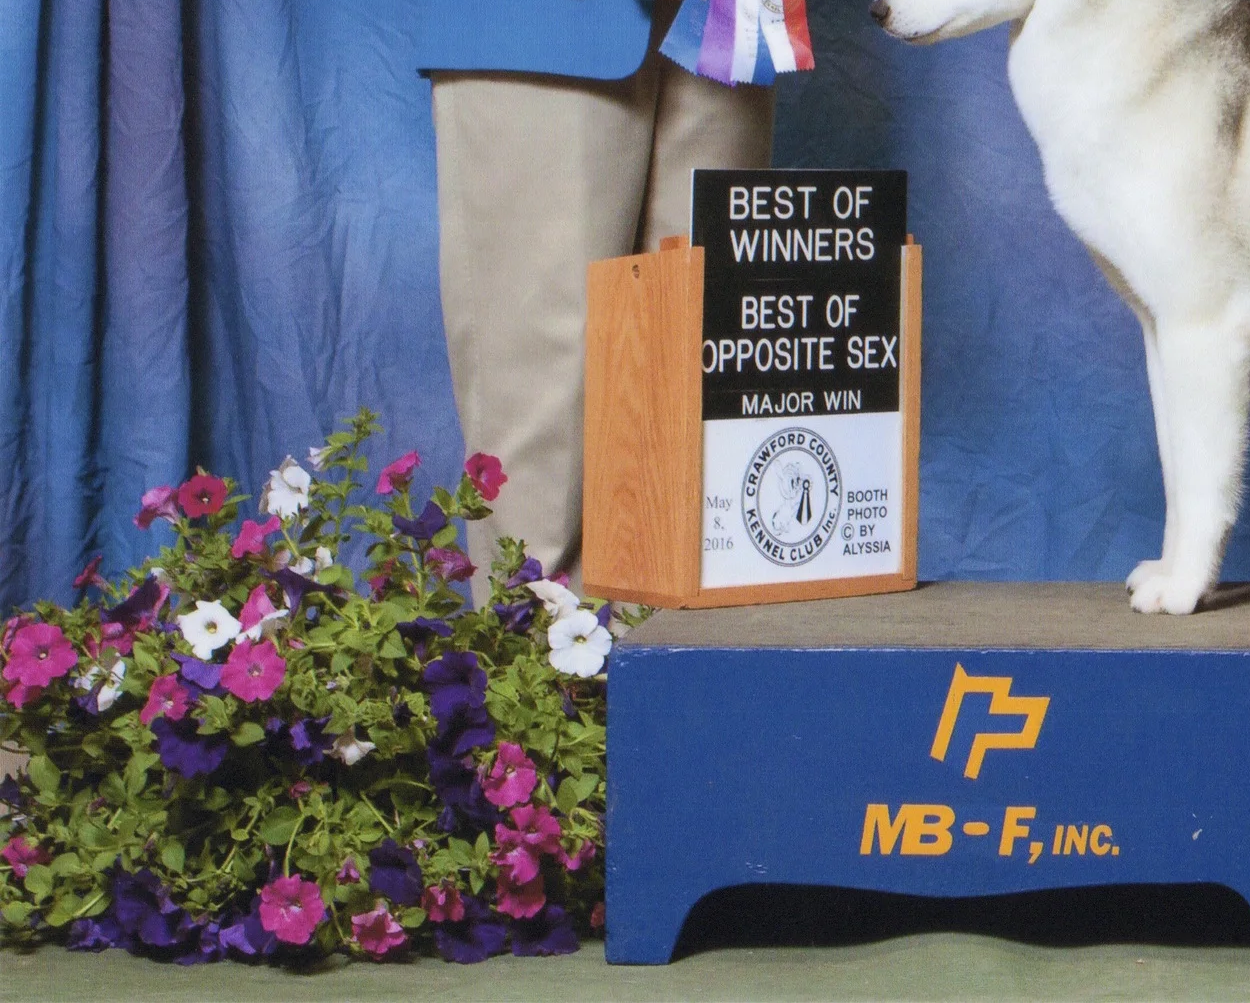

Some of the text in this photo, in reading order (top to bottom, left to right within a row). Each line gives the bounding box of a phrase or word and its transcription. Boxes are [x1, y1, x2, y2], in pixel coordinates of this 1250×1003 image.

[729, 186, 873, 220] BEST OF
[730, 228, 875, 262] WINNERS
[741, 294, 860, 329] BEST OF
[702, 336, 897, 373] OPPOSITE SEX
[742, 390, 861, 415] MAJOR WIN
[746, 433, 839, 497] CRAWFORD COUNTY
[706, 496, 733, 511] May
[847, 489, 888, 504] BOOTH
[847, 506, 888, 521] PHOTO
[704, 538, 734, 551] 2016
[746, 507, 785, 560] KENNEL
[790, 534, 823, 561] CLUB
[859, 524, 875, 537] BY
[842, 541, 891, 556] ALYSSIA
[1052, 824, 1120, 855] INC.
